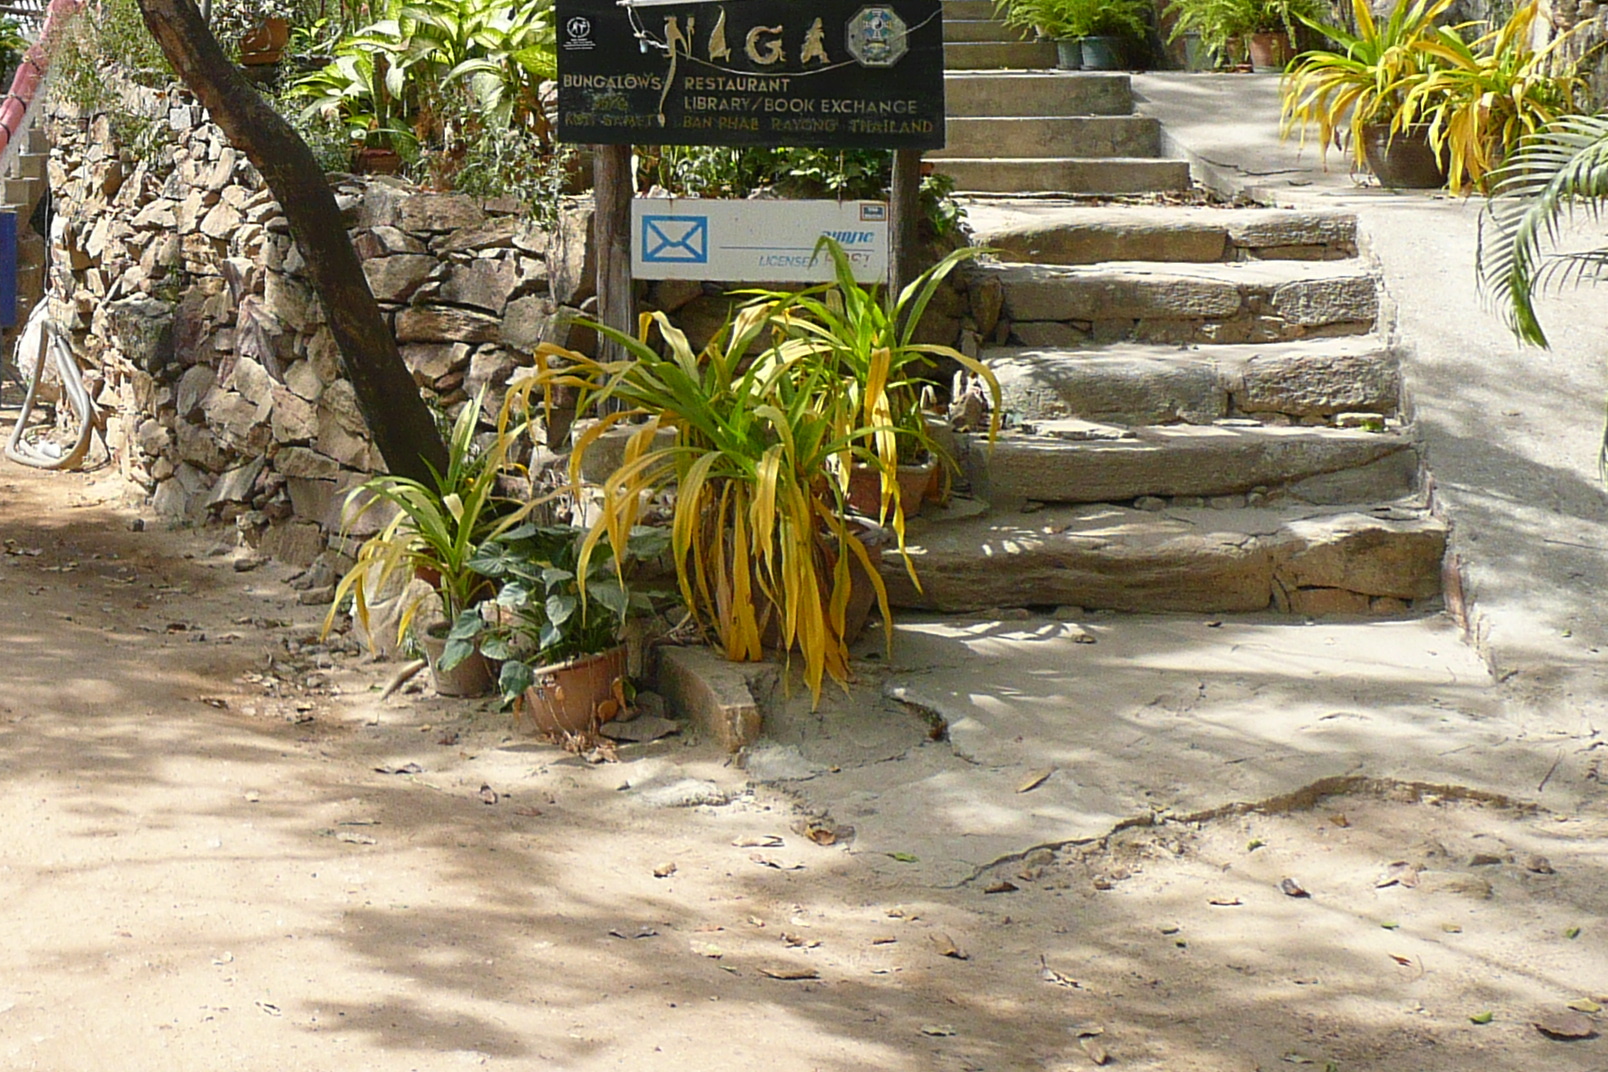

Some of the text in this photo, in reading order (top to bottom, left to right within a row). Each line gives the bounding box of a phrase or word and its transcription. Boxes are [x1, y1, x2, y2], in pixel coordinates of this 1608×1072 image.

[563, 73, 663, 91] BUNGALOWS
[684, 77, 791, 93] RESTAURANT
[683, 95, 918, 114] LIBRARY/BOOK EXCHANGE
[683, 114, 713, 129] BAN
[758, 254, 819, 268] LICENSED
